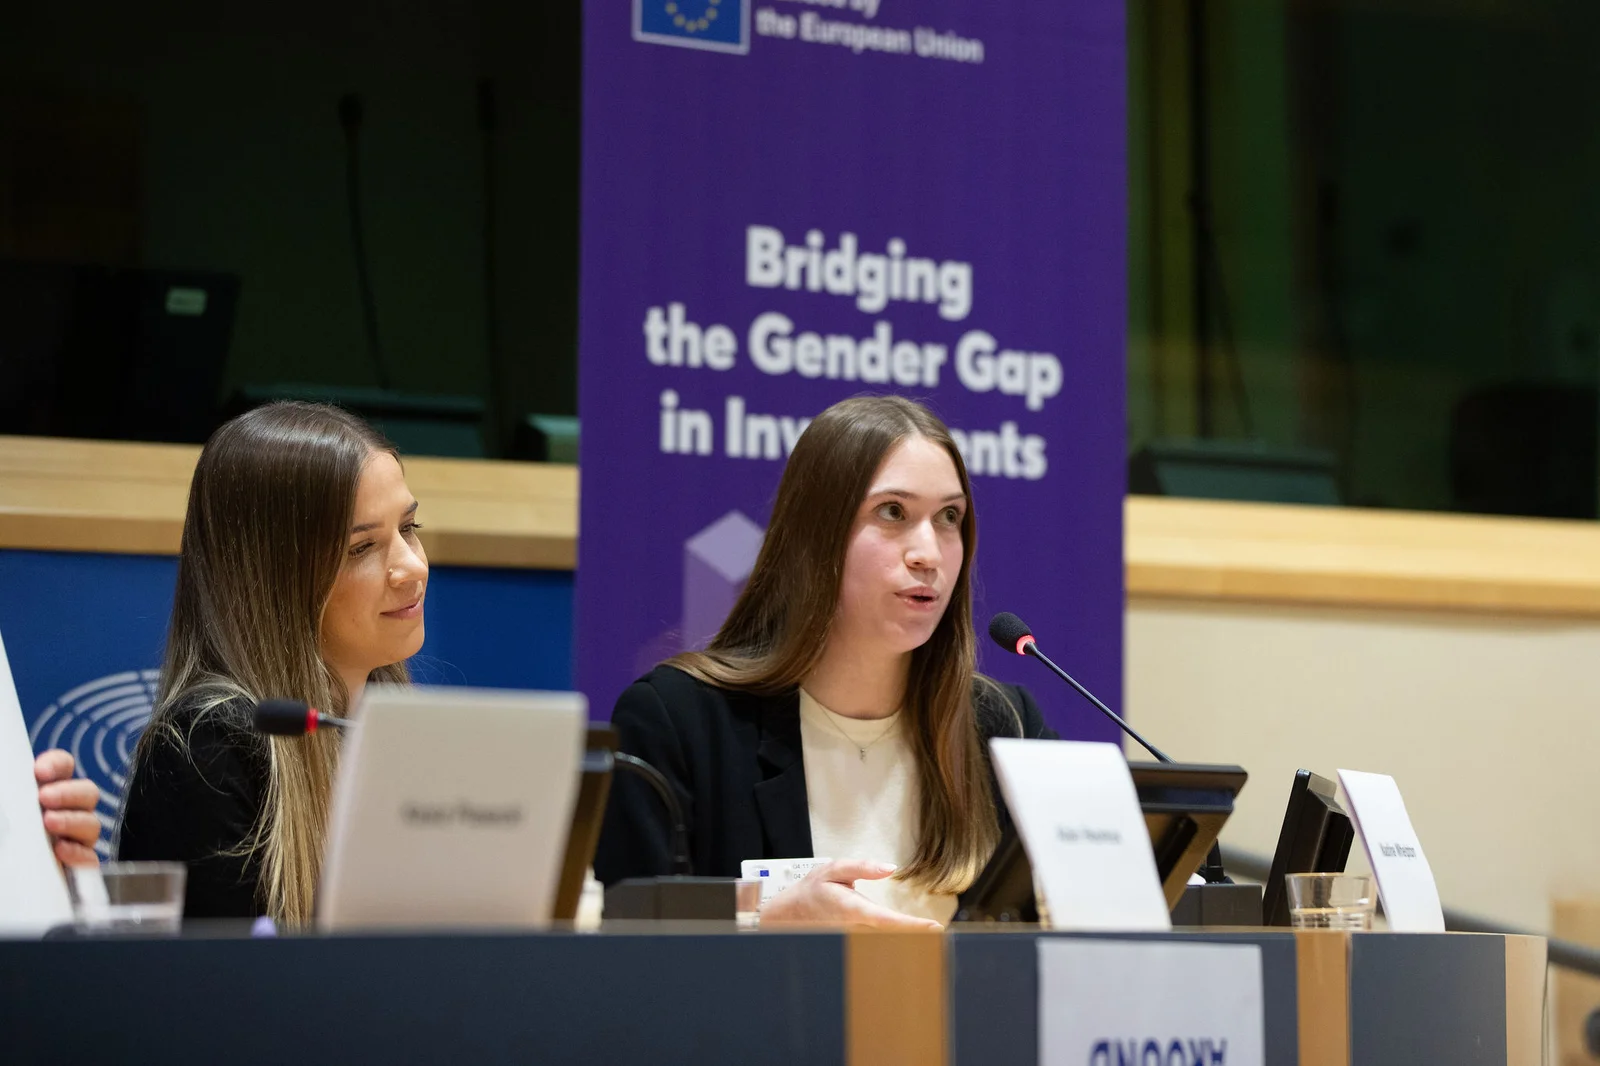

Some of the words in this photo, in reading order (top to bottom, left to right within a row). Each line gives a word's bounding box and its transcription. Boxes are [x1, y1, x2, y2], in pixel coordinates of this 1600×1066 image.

[756, 9, 797, 38] the
[800, 10, 912, 54] European
[914, 29, 984, 62] Union
[746, 225, 973, 321] Bridging
[643, 302, 738, 371] the
[748, 311, 948, 388] Gender
[954, 330, 1064, 411] Gap
[660, 389, 713, 456] in
